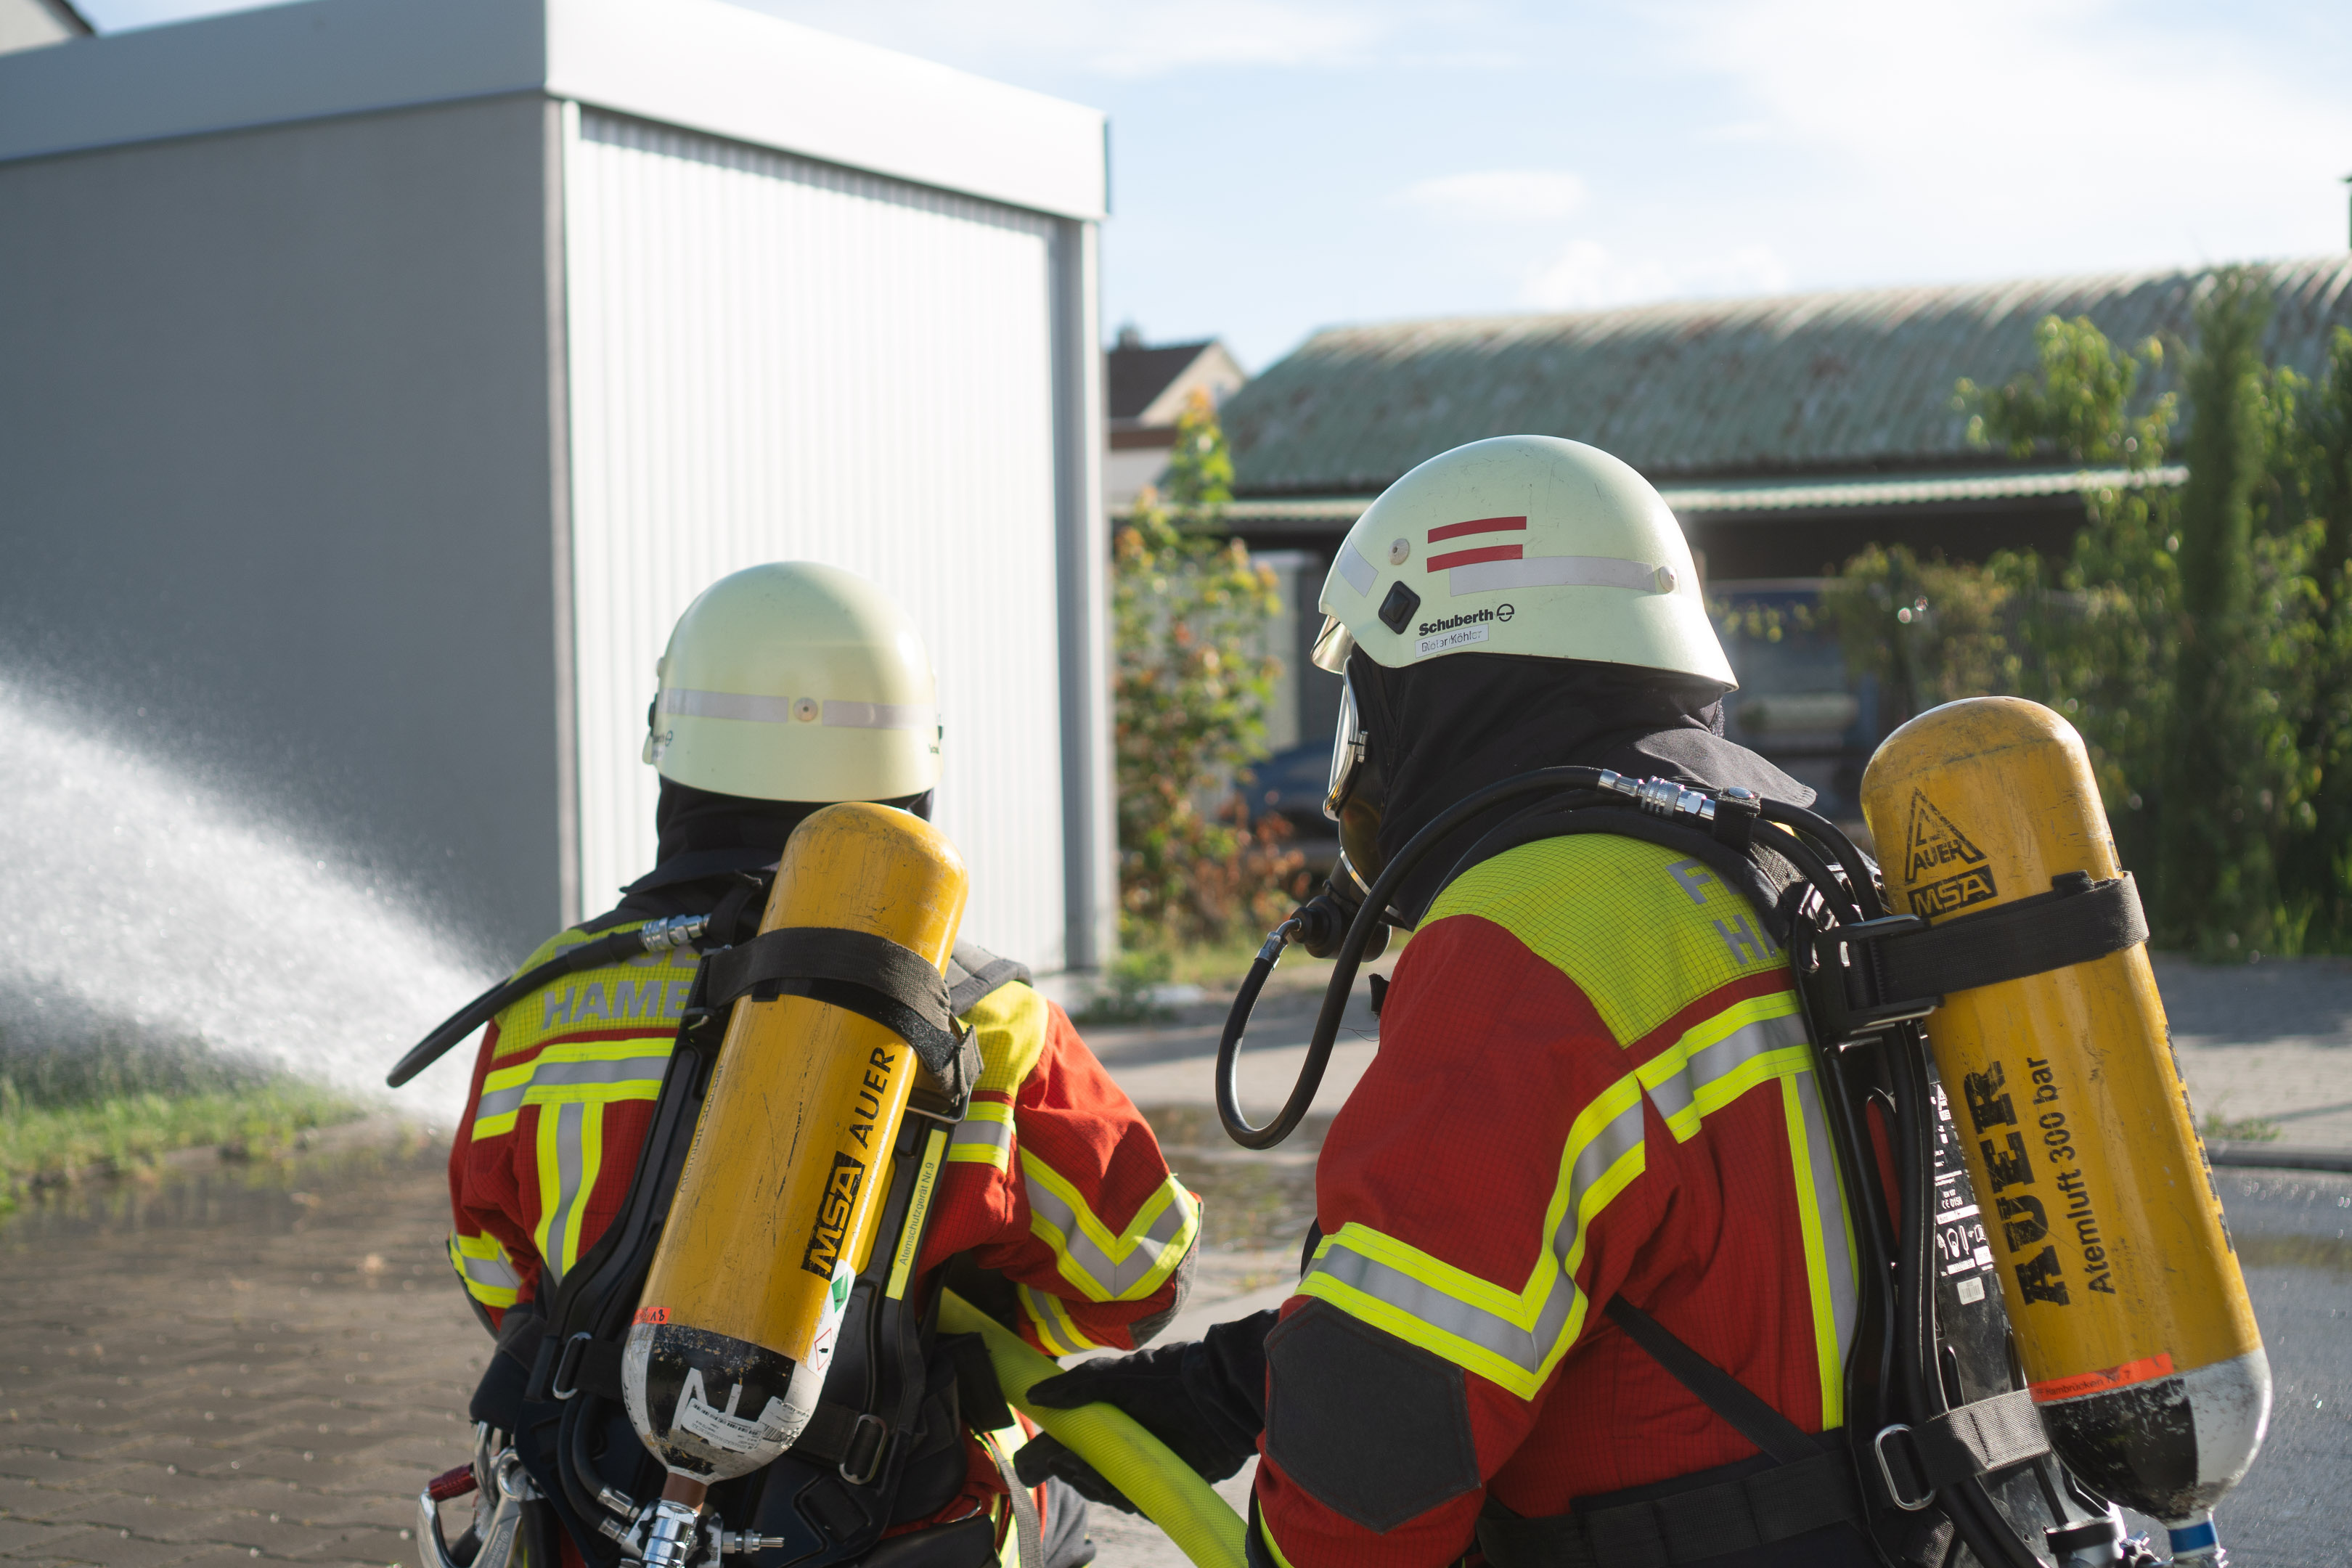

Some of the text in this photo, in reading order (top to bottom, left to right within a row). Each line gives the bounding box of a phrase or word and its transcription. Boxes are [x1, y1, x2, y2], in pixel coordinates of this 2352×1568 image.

[1418, 609, 1494, 637] Schuberth
[1914, 839, 1961, 870] AUER
[1914, 874, 1993, 917] MSA
[808, 1046, 896, 1274] MSA AUER
[1964, 1060, 2070, 1306] AUER
[2026, 1056, 2117, 1295] Atemluft 300 bar
[899, 1185, 929, 1266] Atemschutzgerät
[650, 1308, 665, 1321] 18
